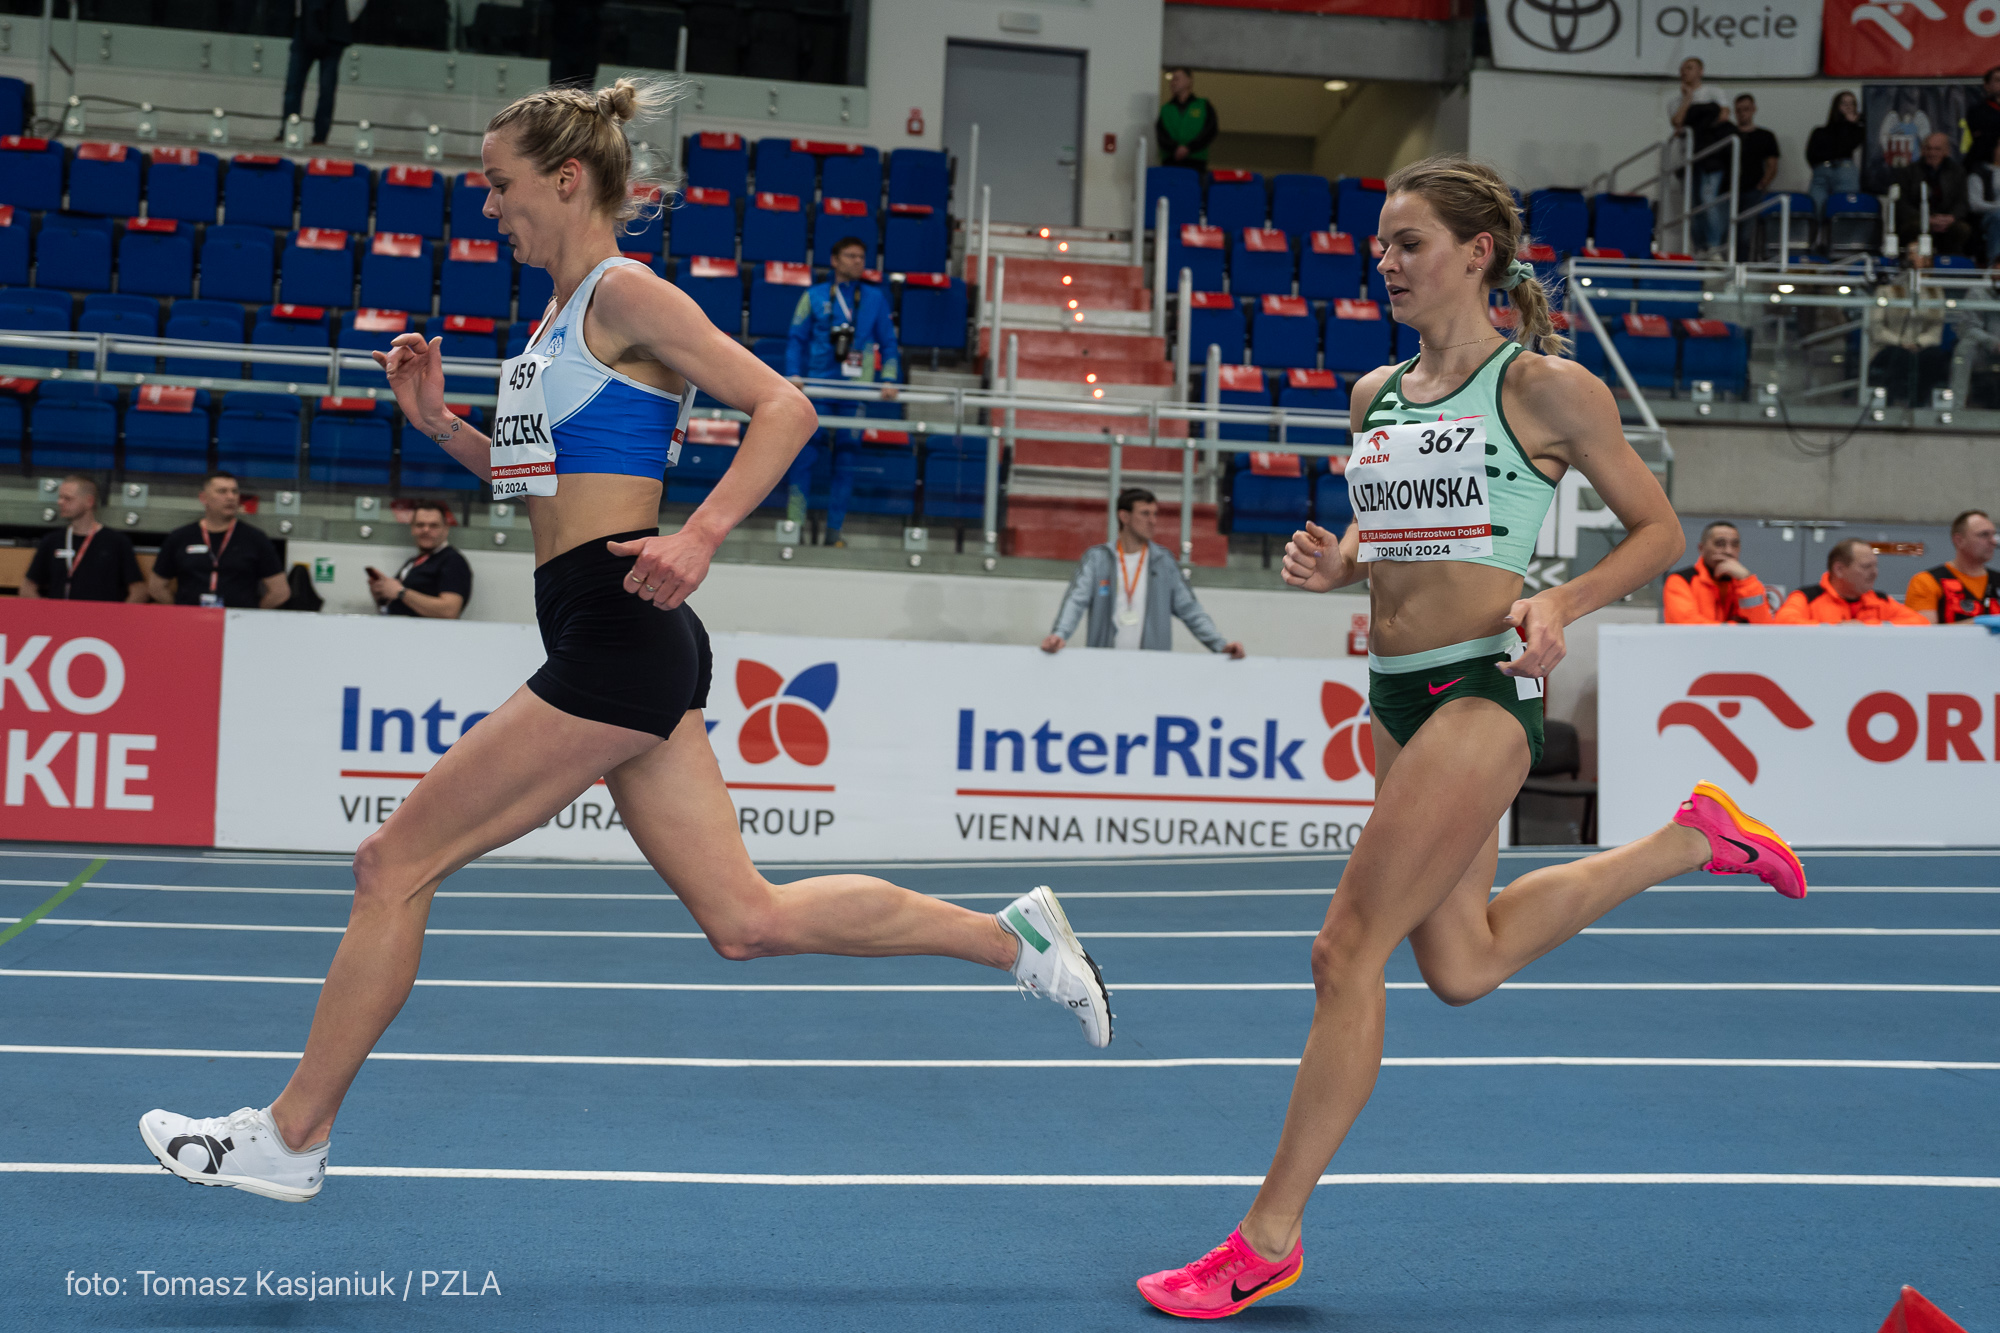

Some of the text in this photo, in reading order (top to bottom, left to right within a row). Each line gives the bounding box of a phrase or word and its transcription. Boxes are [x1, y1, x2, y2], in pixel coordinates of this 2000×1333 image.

[1656, 7, 1797, 46] Okęcie
[509, 362, 537, 391] 459
[490, 413, 549, 448] IECZEK
[1418, 427, 1475, 455] 367
[499, 467, 531, 476] Mistrzostwa
[531, 464, 551, 473] Polski
[1359, 453, 1390, 466] ORLEN
[505, 482, 528, 494] 2024
[1353, 476, 1484, 513] LIZAKOWSKA
[1379, 531, 1403, 540] Halowe
[1404, 528, 1456, 539] Mistrzostwa
[1457, 526, 1485, 537] Polski
[1376, 543, 1451, 557] TORUŃ 2024
[1847, 690, 2000, 764] OR
[956, 707, 1306, 781] InterRisk
[955, 813, 1084, 843] VIENNA
[1096, 816, 1289, 848] INSURANCE
